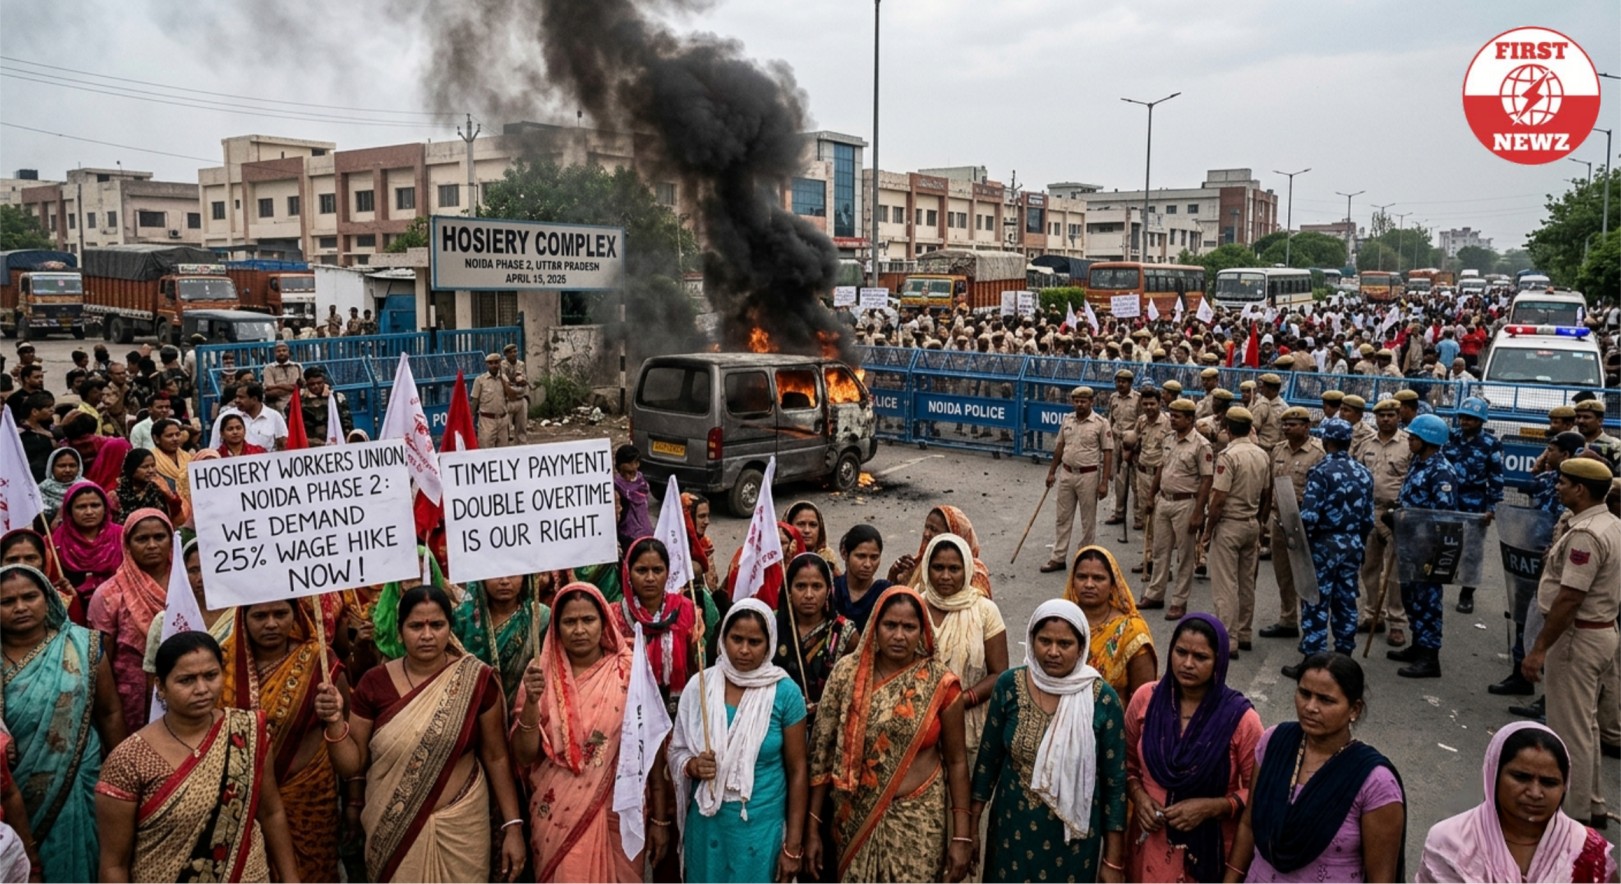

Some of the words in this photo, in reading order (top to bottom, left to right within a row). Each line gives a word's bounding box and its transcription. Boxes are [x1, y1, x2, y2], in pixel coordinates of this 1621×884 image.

[442, 225, 530, 255] HOSIERY
[535, 231, 617, 258] COMPLEX
[465, 258, 493, 269] NOIDA
[496, 259, 524, 270] PHASE
[526, 260, 534, 271] 2,
[505, 273, 531, 284] APRIL
[534, 274, 546, 285] 15,
[874, 395, 898, 409] LICE
[928, 400, 962, 416] NOIDA
[964, 403, 1005, 420] POLICE
[194, 459, 271, 490] HOSIERY
[277, 450, 354, 480] WORKERS
[358, 444, 409, 471] UNION,
[448, 457, 520, 487] TIMELY
[528, 450, 611, 479] PAYMENT,
[1502, 454, 1537, 473] OID
[240, 485, 301, 512] NOIDA
[307, 476, 364, 504] PHASE
[452, 491, 526, 521] DOUBLE
[531, 482, 612, 512] OVERTIME
[221, 519, 258, 543] WE
[268, 505, 365, 537] DEMAND
[462, 528, 482, 553] IS
[489, 523, 532, 549] OUR
[540, 514, 602, 543] RIGHT.
[213, 543, 267, 574] 25%
[276, 534, 339, 564] WAGE
[348, 525, 399, 553] HIKE
[1510, 555, 1541, 575] RAF
